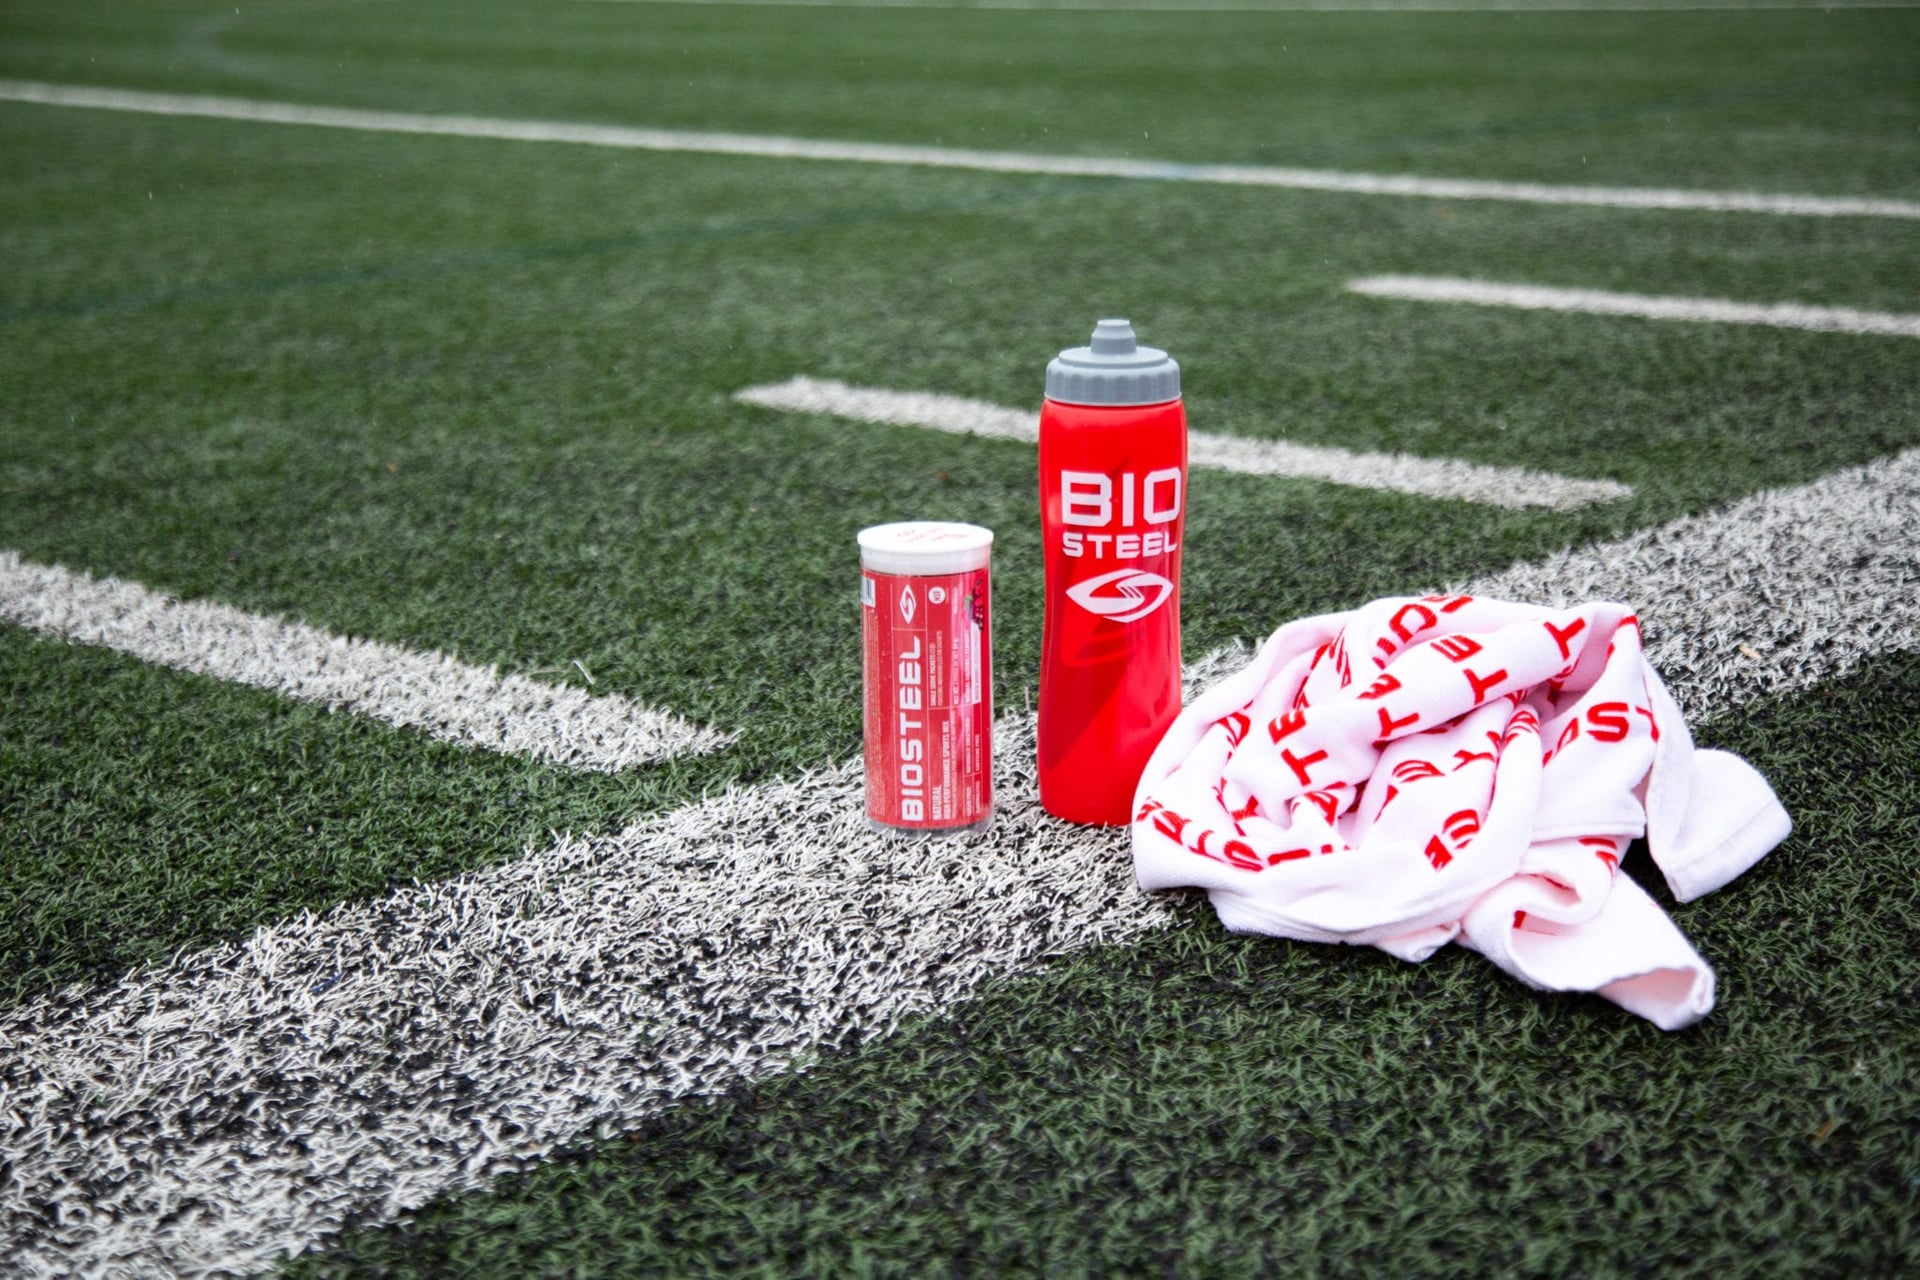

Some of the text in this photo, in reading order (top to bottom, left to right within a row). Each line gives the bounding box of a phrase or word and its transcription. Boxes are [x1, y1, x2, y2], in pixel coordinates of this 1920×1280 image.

[1061, 467, 1182, 527] BIO
[1062, 531, 1178, 559] STEEL
[898, 635, 924, 822] BIOSTEEL
[942, 734, 950, 757] SPORTS
[943, 758, 951, 804] PERFORMANCE
[932, 785, 942, 820] NATURAL
